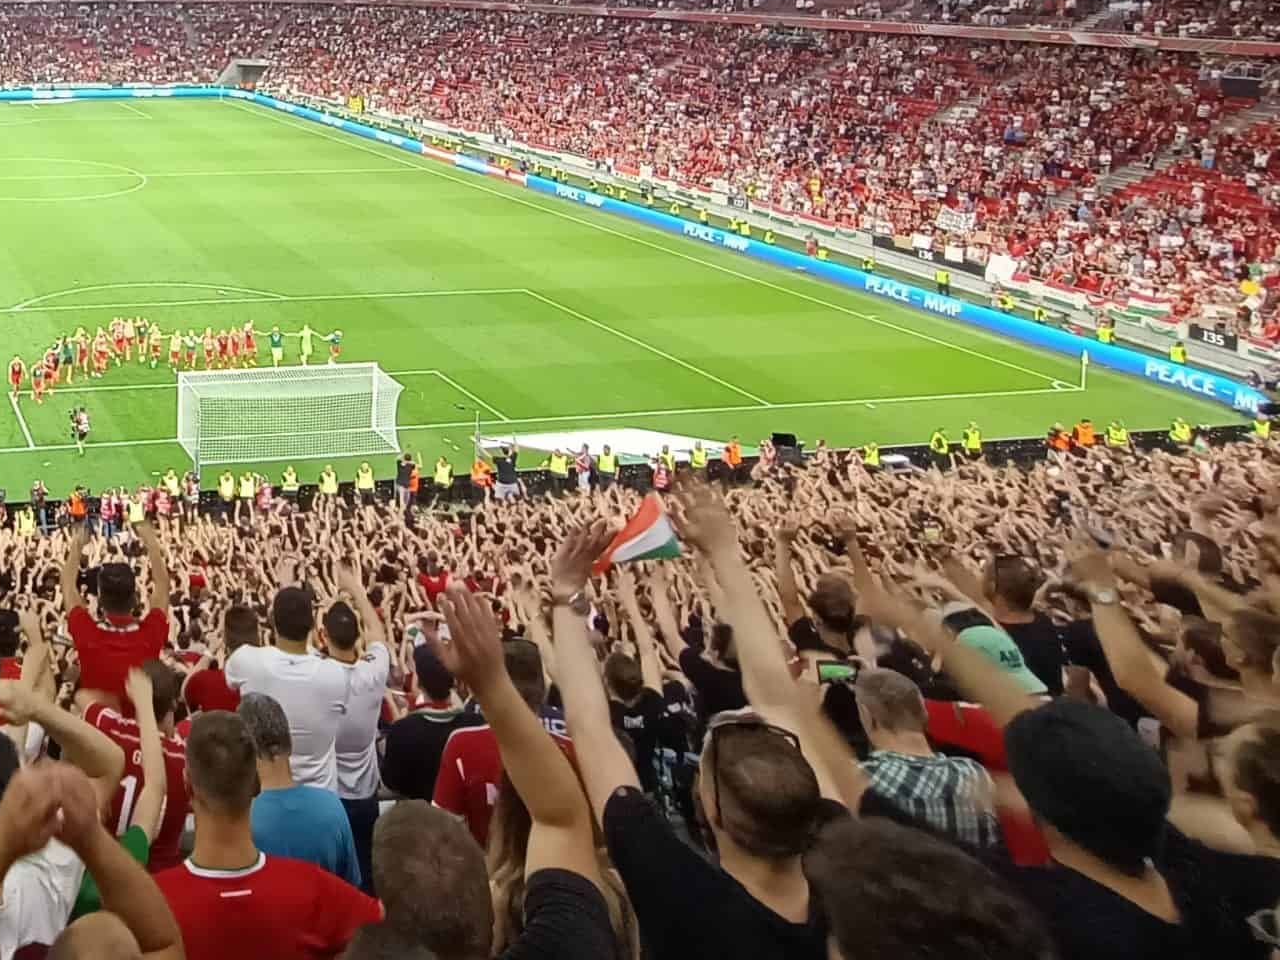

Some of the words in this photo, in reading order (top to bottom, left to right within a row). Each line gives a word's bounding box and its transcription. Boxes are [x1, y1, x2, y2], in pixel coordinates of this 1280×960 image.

[683, 223, 714, 243] PEACE
[865, 277, 909, 302] PEACE
[1202, 331, 1225, 346] 135
[1145, 360, 1217, 396] PEACE
